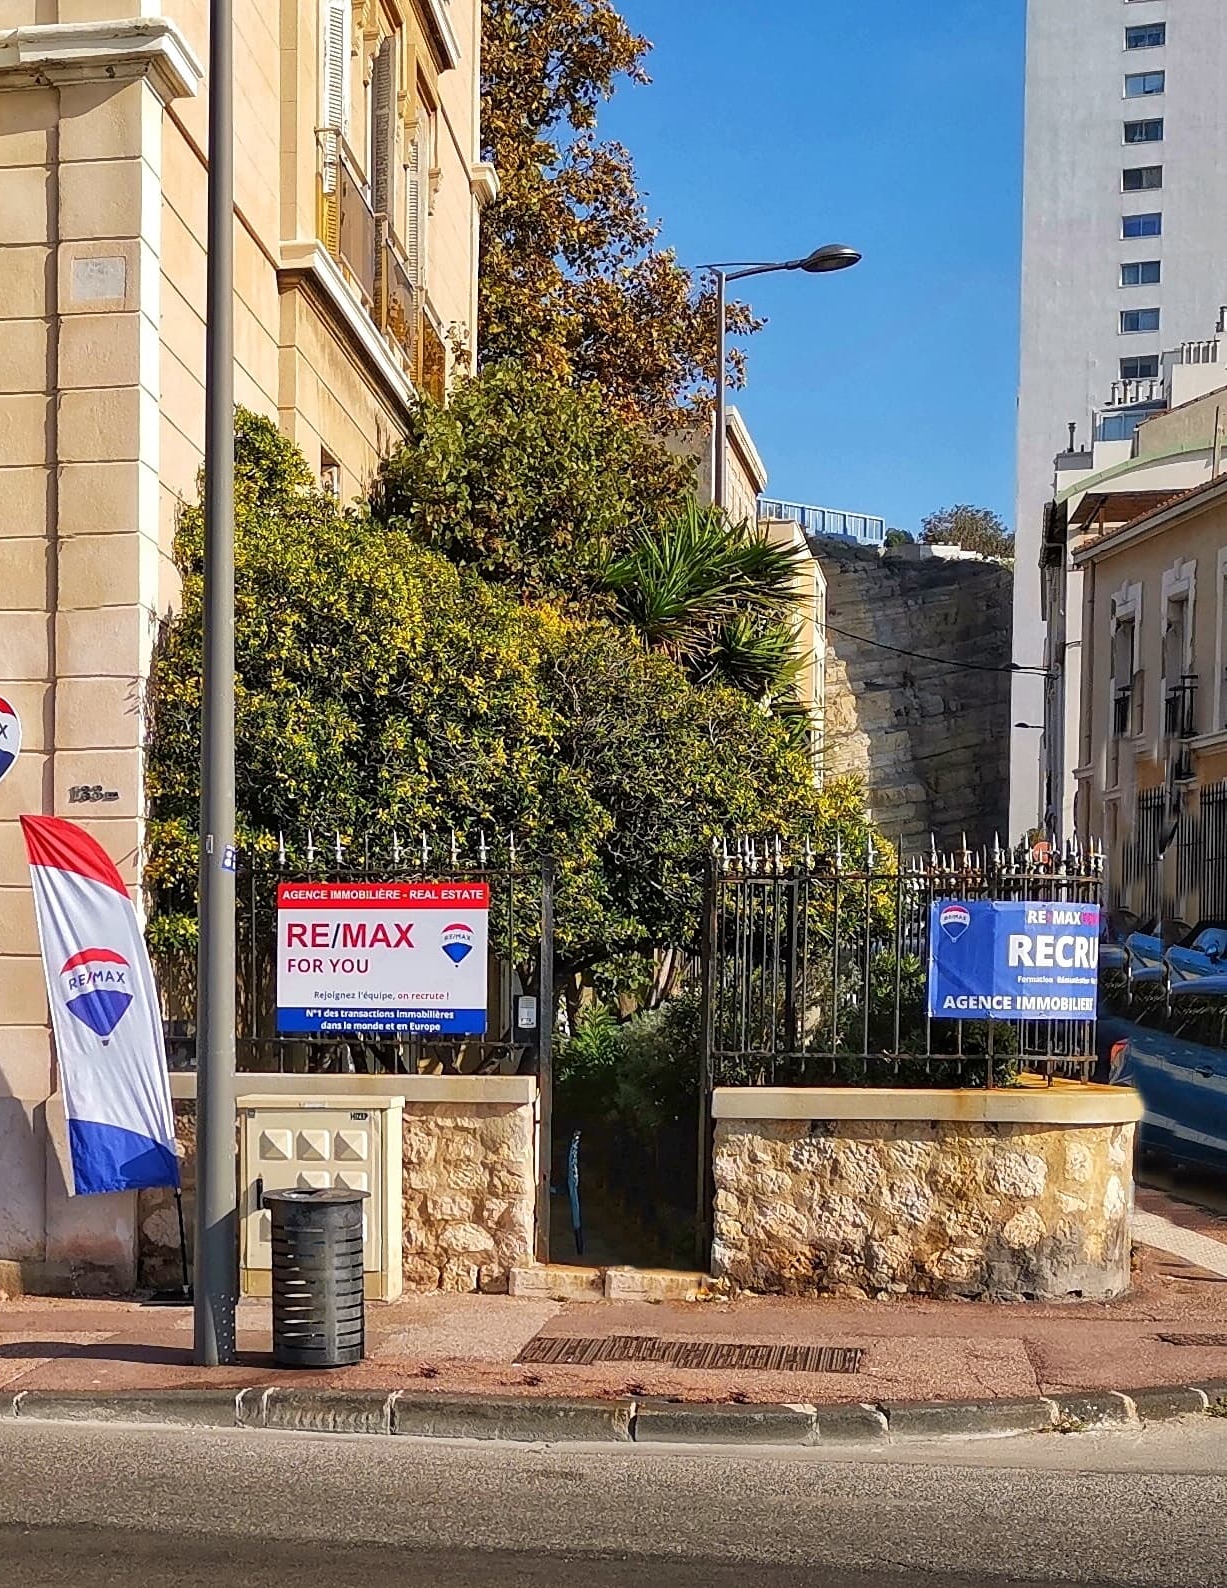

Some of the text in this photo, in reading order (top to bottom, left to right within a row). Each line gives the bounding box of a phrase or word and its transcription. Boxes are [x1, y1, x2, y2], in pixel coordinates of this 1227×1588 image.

[282, 890, 327, 900] AGENCE
[330, 888, 401, 900] IMMOBILIÈRE
[409, 890, 438, 900] REAL
[441, 889, 483, 900] ESTATE
[286, 923, 415, 948] RE/MAX
[287, 958, 369, 973] FOR YOU
[68, 970, 125, 990] RE/MAX
[314, 991, 355, 1001] Rejoignez
[411, 992, 445, 1000] recrute
[943, 995, 1012, 1010] AGENCE
[324, 1009, 339, 1018] des
[340, 1010, 395, 1019] transactions
[321, 1021, 342, 1030] dans
[353, 1021, 384, 1031] monde
[385, 1023, 395, 1031] et
[396, 1023, 408, 1031] en
[409, 1022, 441, 1033] Europe
